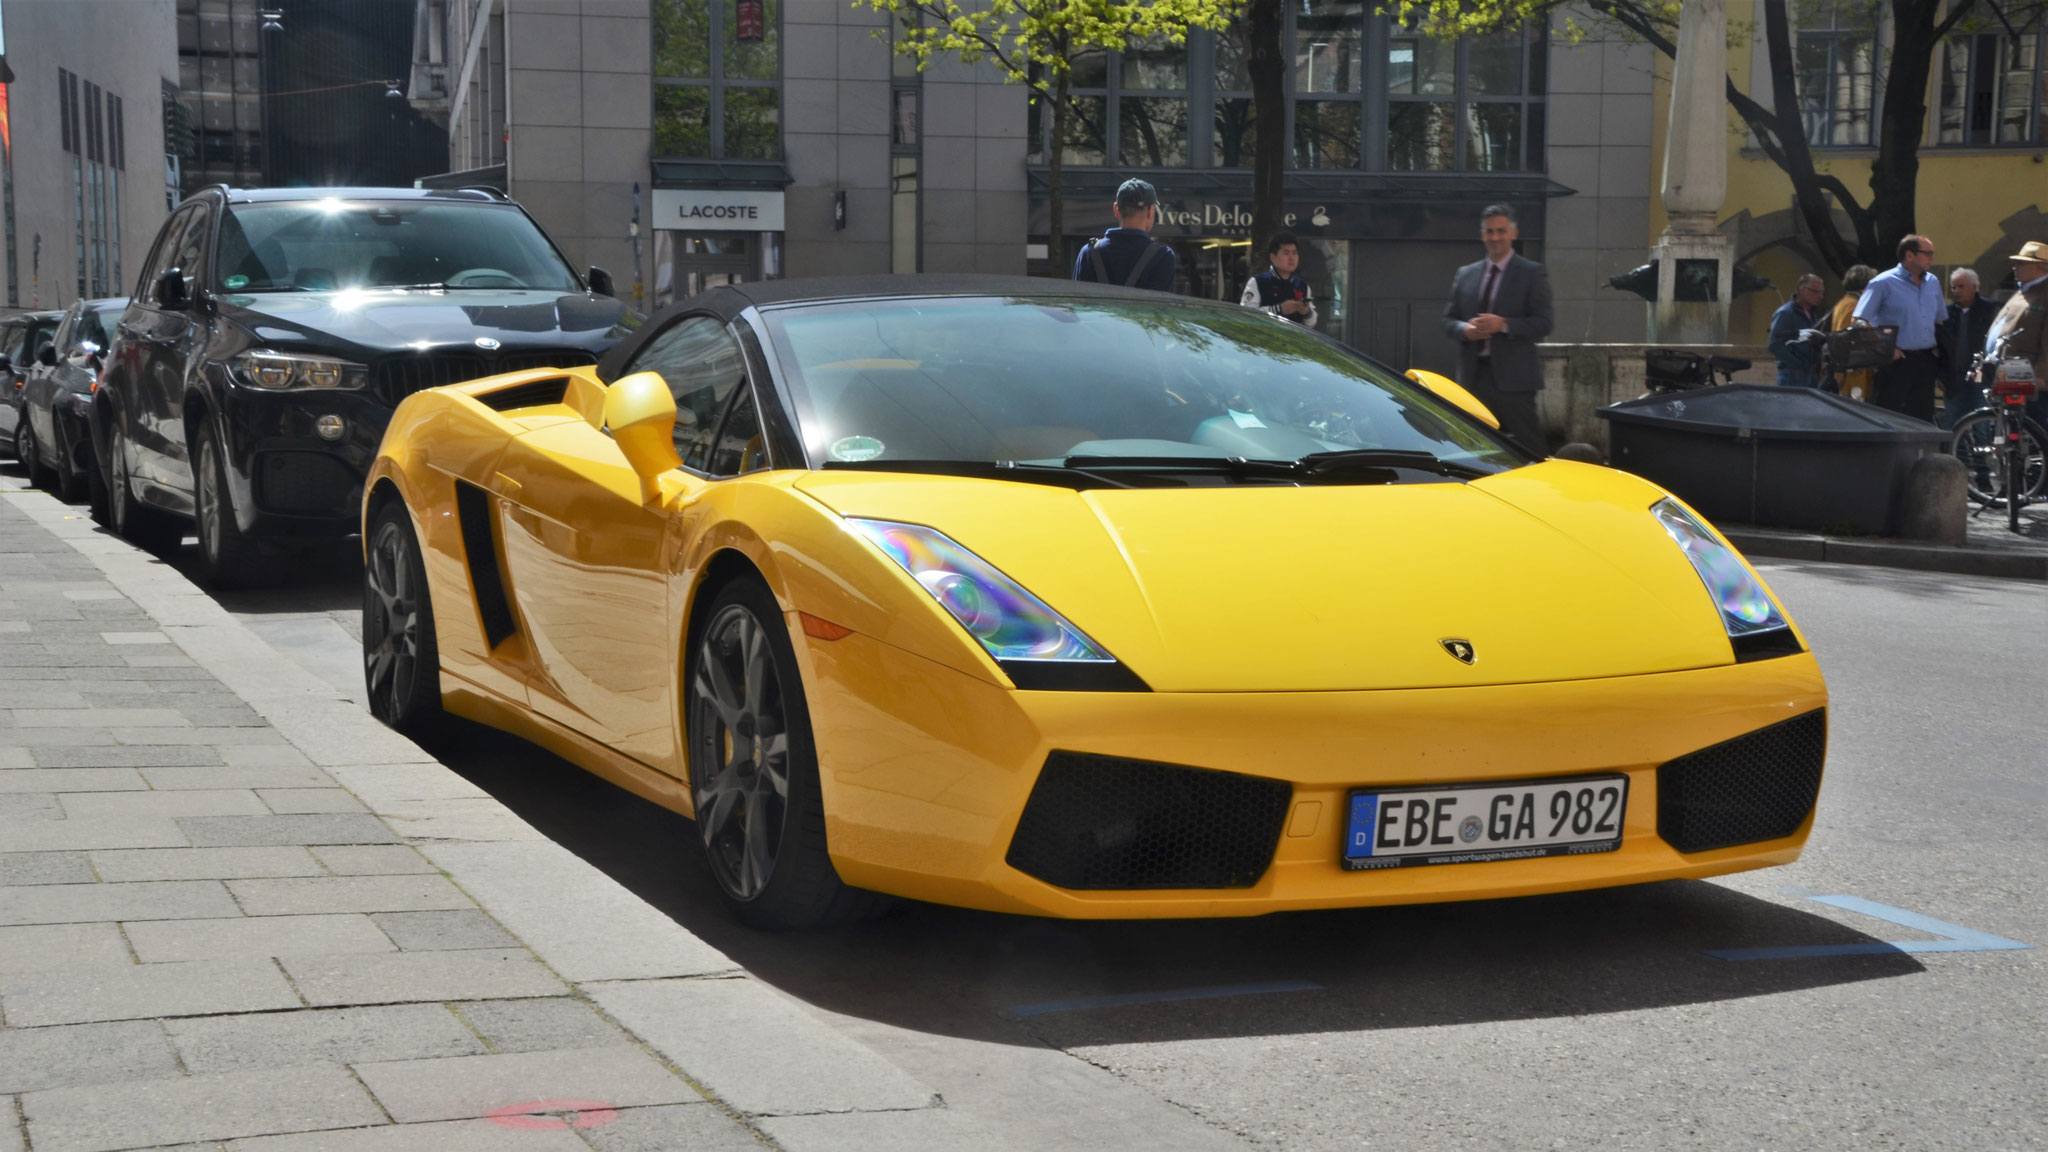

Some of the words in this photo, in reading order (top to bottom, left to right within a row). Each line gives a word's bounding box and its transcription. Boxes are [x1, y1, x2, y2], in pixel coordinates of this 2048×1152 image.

[679, 205, 758, 219] LACOSTE
[1155, 203, 1200, 226] Yves
[1204, 204, 1297, 227] Deloe
[1376, 797, 1457, 849] EBE
[1487, 792, 1535, 842] GA
[1548, 786, 1619, 837] 982
[1355, 831, 1366, 847] D
[1428, 848, 1547, 863] www.sportwagen-landshut.de
